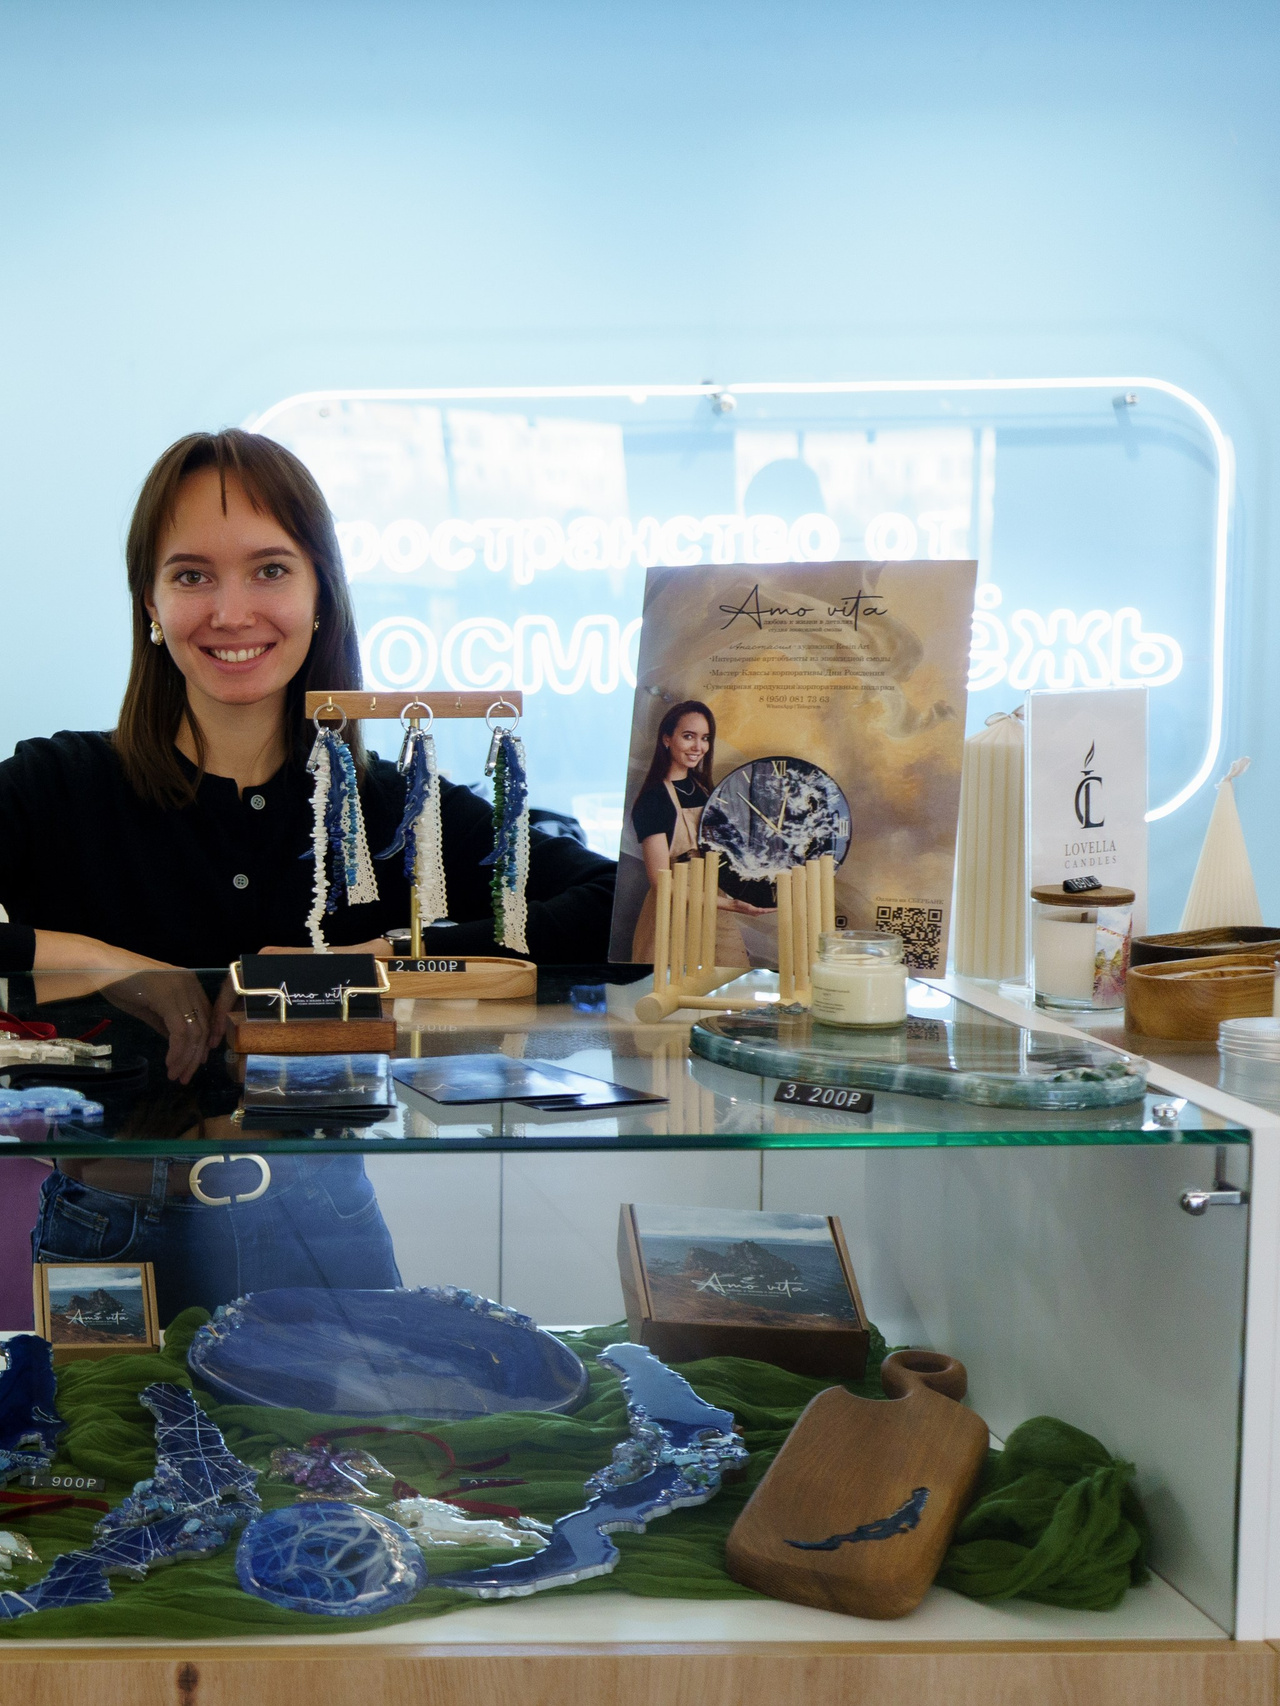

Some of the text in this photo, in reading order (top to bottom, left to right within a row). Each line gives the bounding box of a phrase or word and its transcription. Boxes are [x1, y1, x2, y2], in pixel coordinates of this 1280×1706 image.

[334, 514, 840, 585] ространство
[719, 584, 814, 630] Amo
[766, 694, 787, 703] (950)
[789, 695, 803, 703] 081
[1064, 840, 1116, 857] LOVELLA
[1064, 855, 1117, 869] CANDLES
